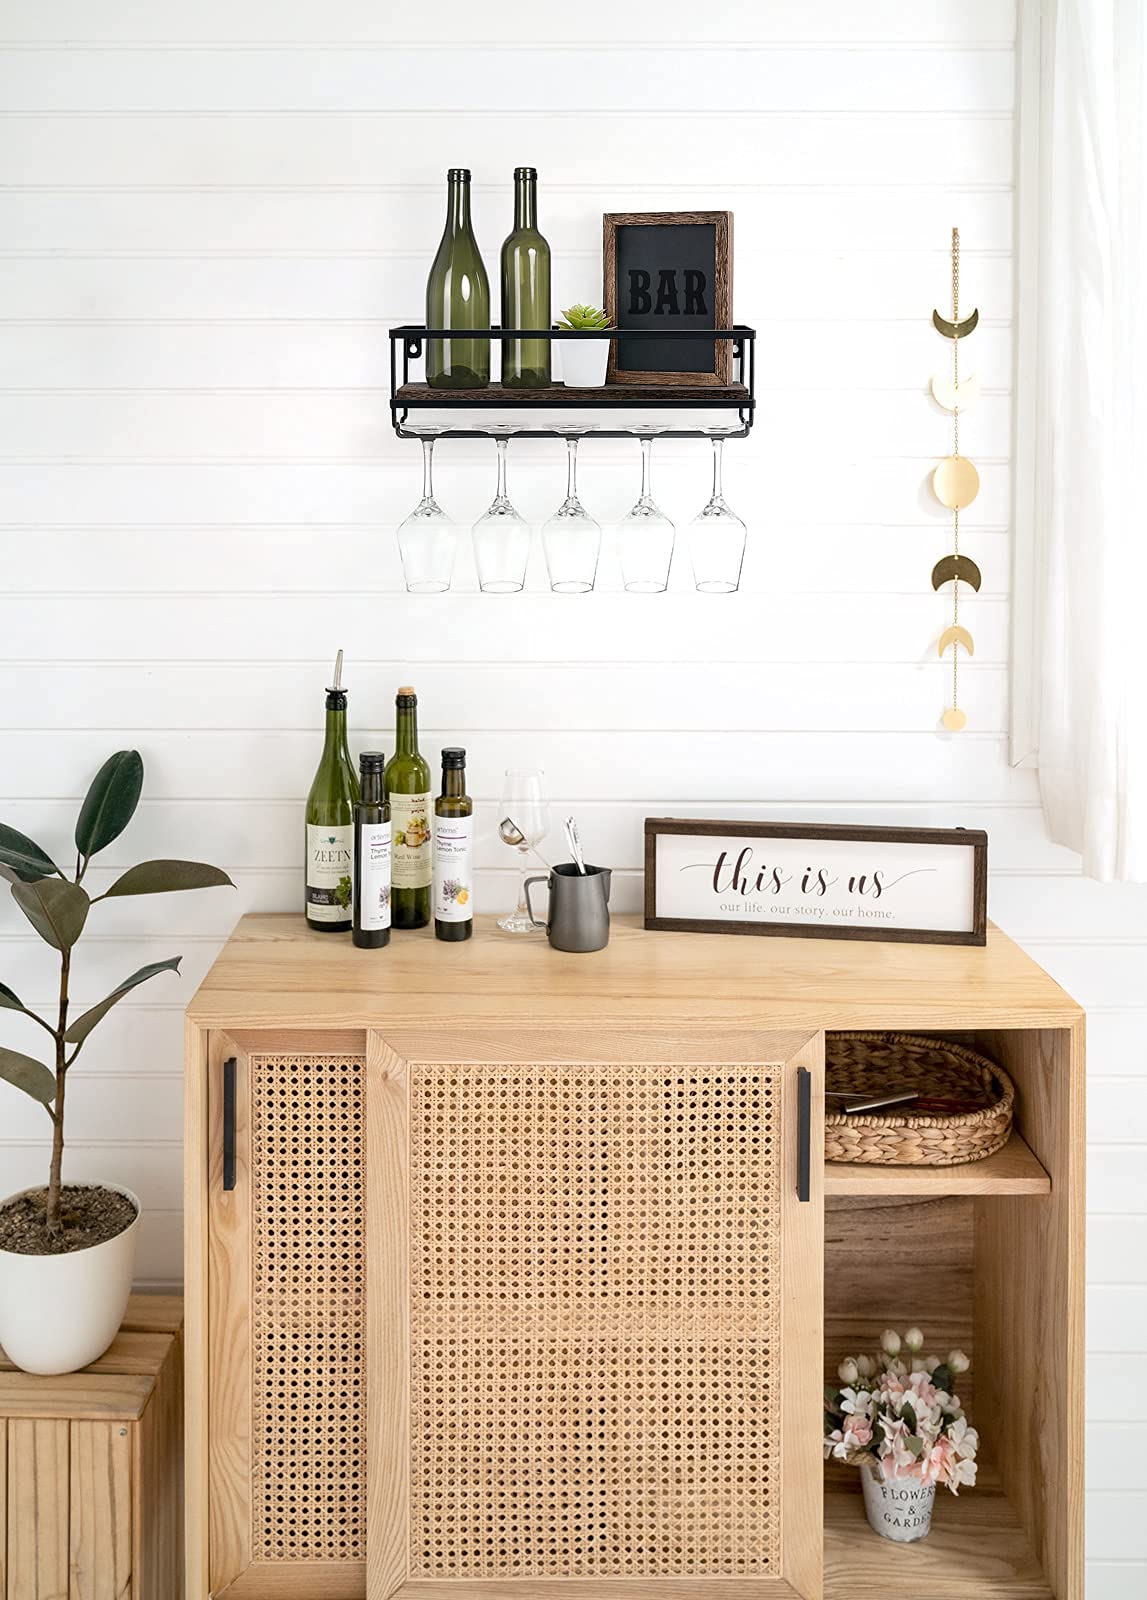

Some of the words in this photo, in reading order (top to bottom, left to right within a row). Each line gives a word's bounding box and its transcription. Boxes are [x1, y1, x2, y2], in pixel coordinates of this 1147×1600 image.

[628, 269, 708, 315] BAR
[314, 849, 351, 862] ZEETN
[680, 846, 793, 896] this
[801, 866, 839, 897] is
[719, 903, 741, 912] our
[744, 902, 766, 913] life.
[770, 905, 791, 914] our
[795, 905, 829, 919] story.
[833, 907, 854, 917] our
[857, 907, 896, 919] home.
[908, 1506, 917, 1515] &
